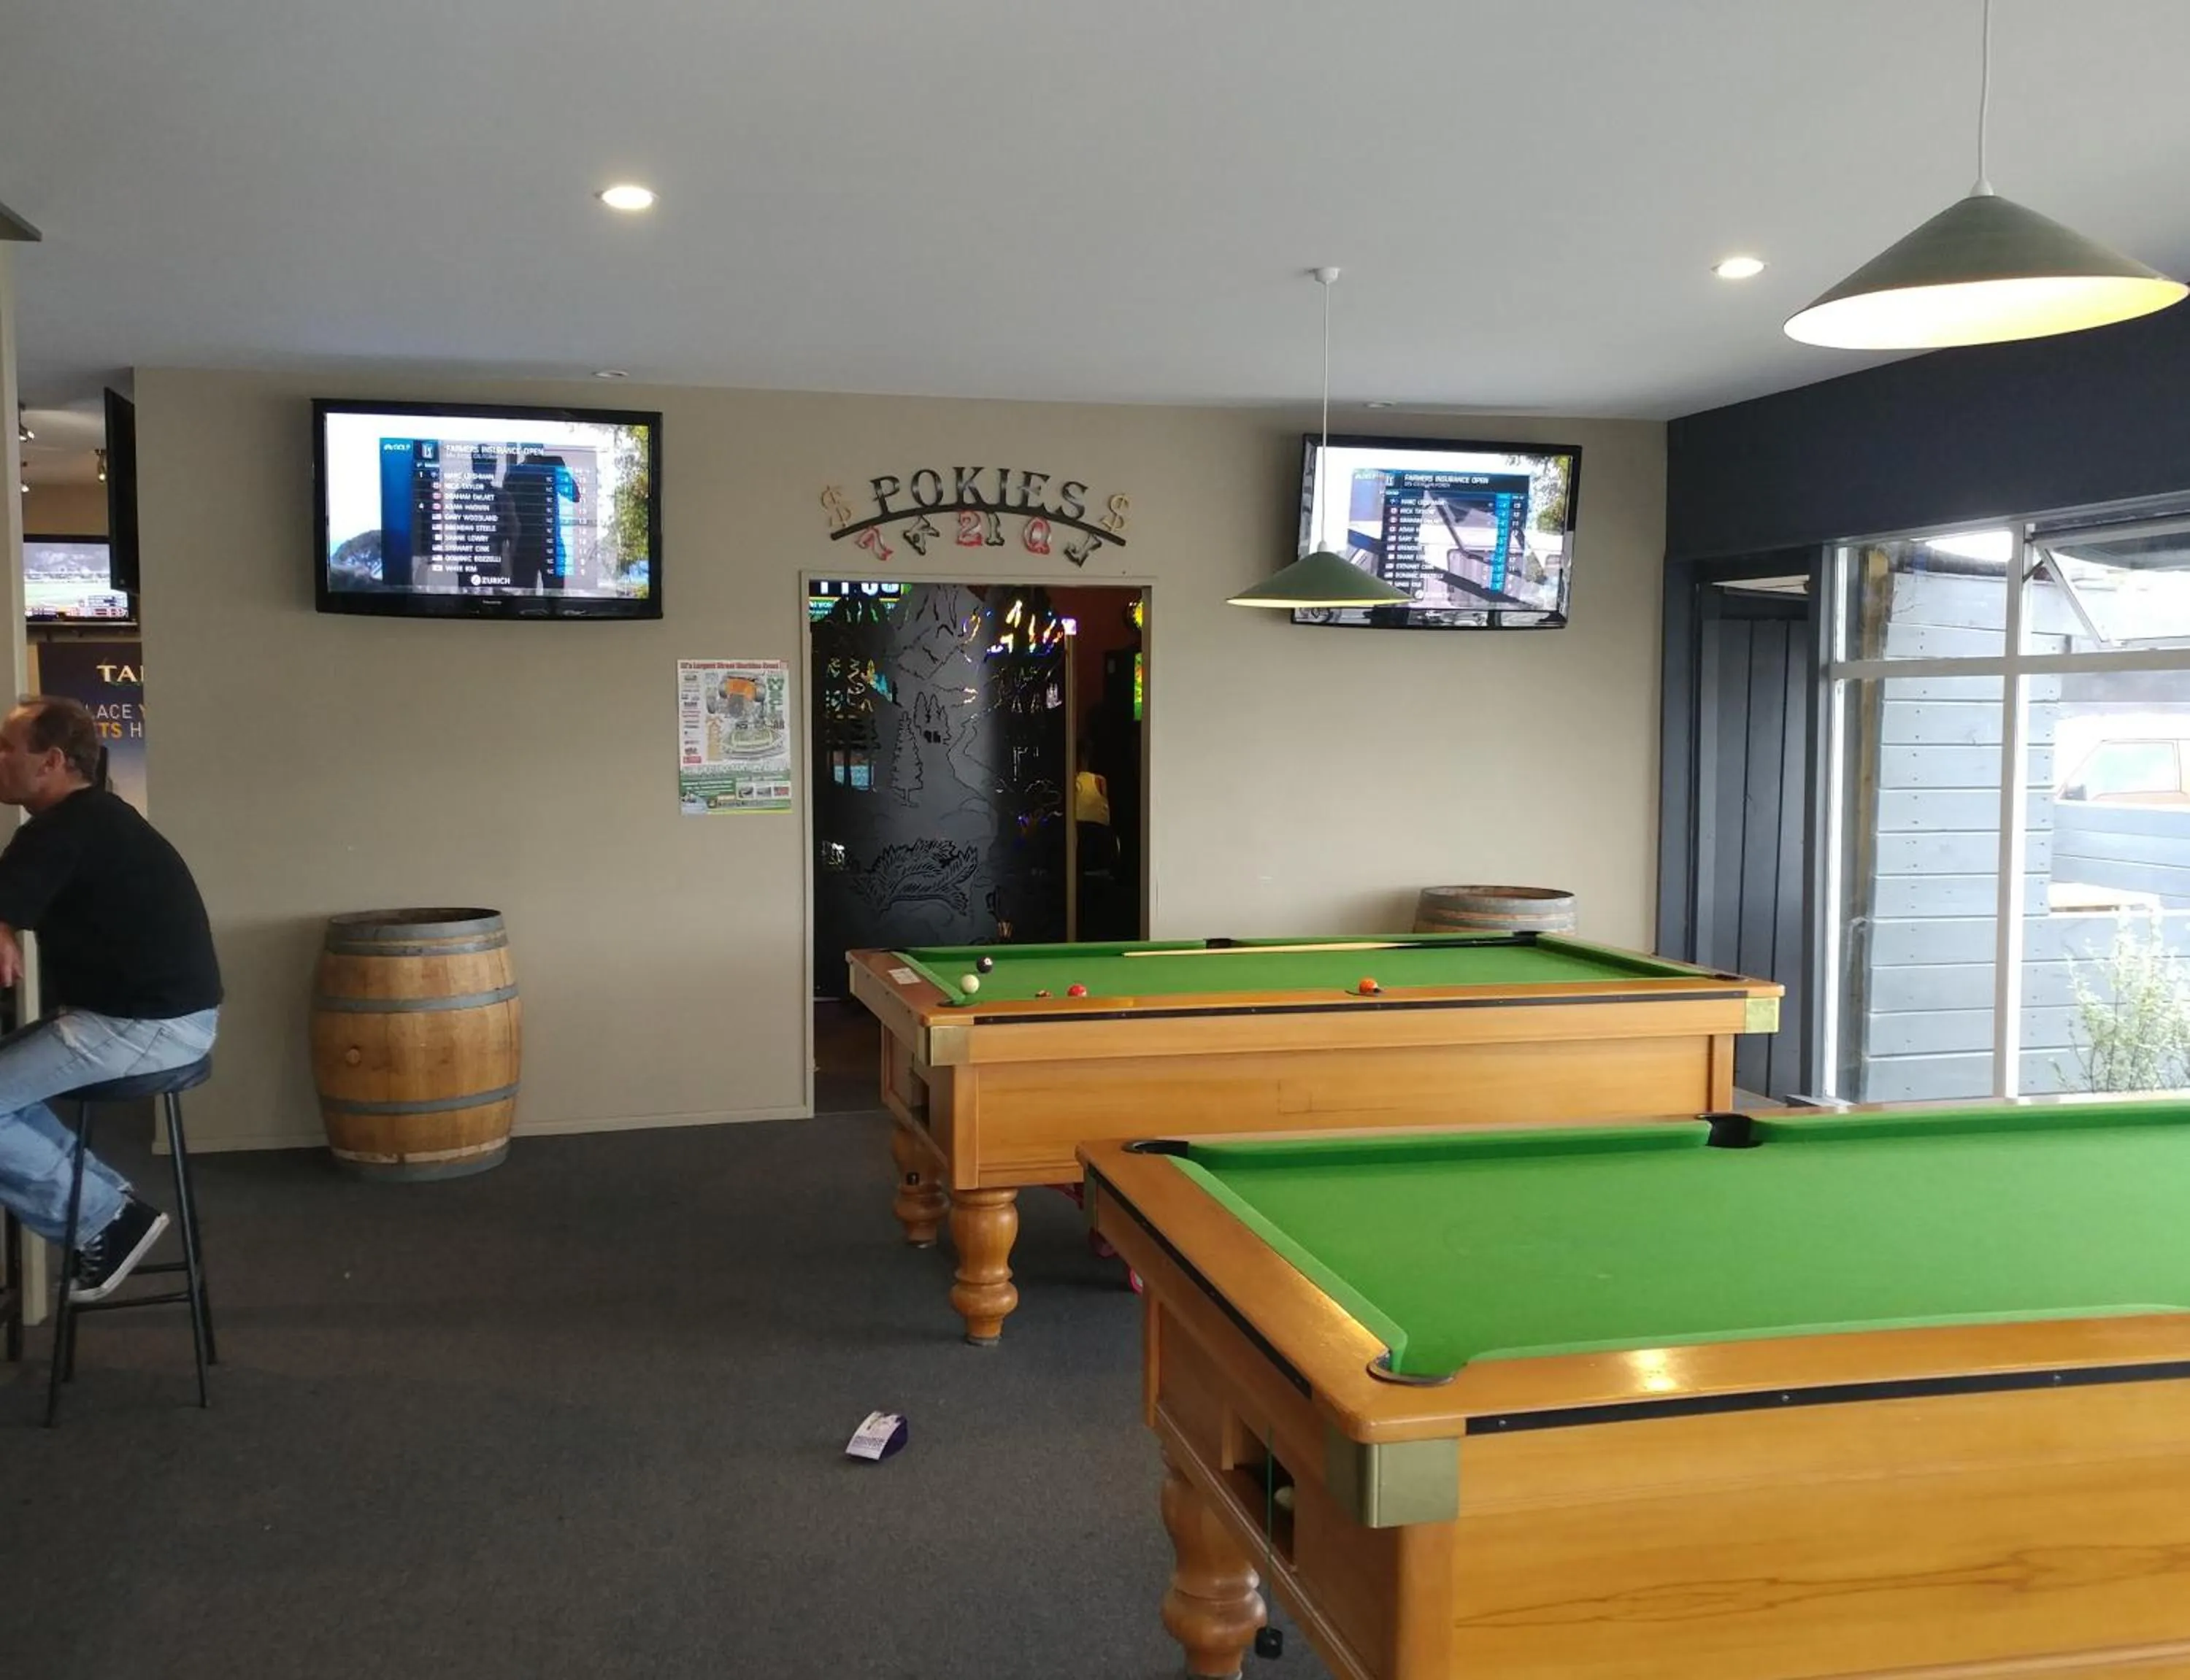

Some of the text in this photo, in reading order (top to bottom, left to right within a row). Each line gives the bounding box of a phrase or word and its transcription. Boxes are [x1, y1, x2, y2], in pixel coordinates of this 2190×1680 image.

[523, 447, 544, 456] OPEN
[869, 466, 1088, 520] POKIES
[1100, 493, 1130, 533] $
[482, 576, 511, 585] ZURICH
[96, 722, 123, 739] TS
